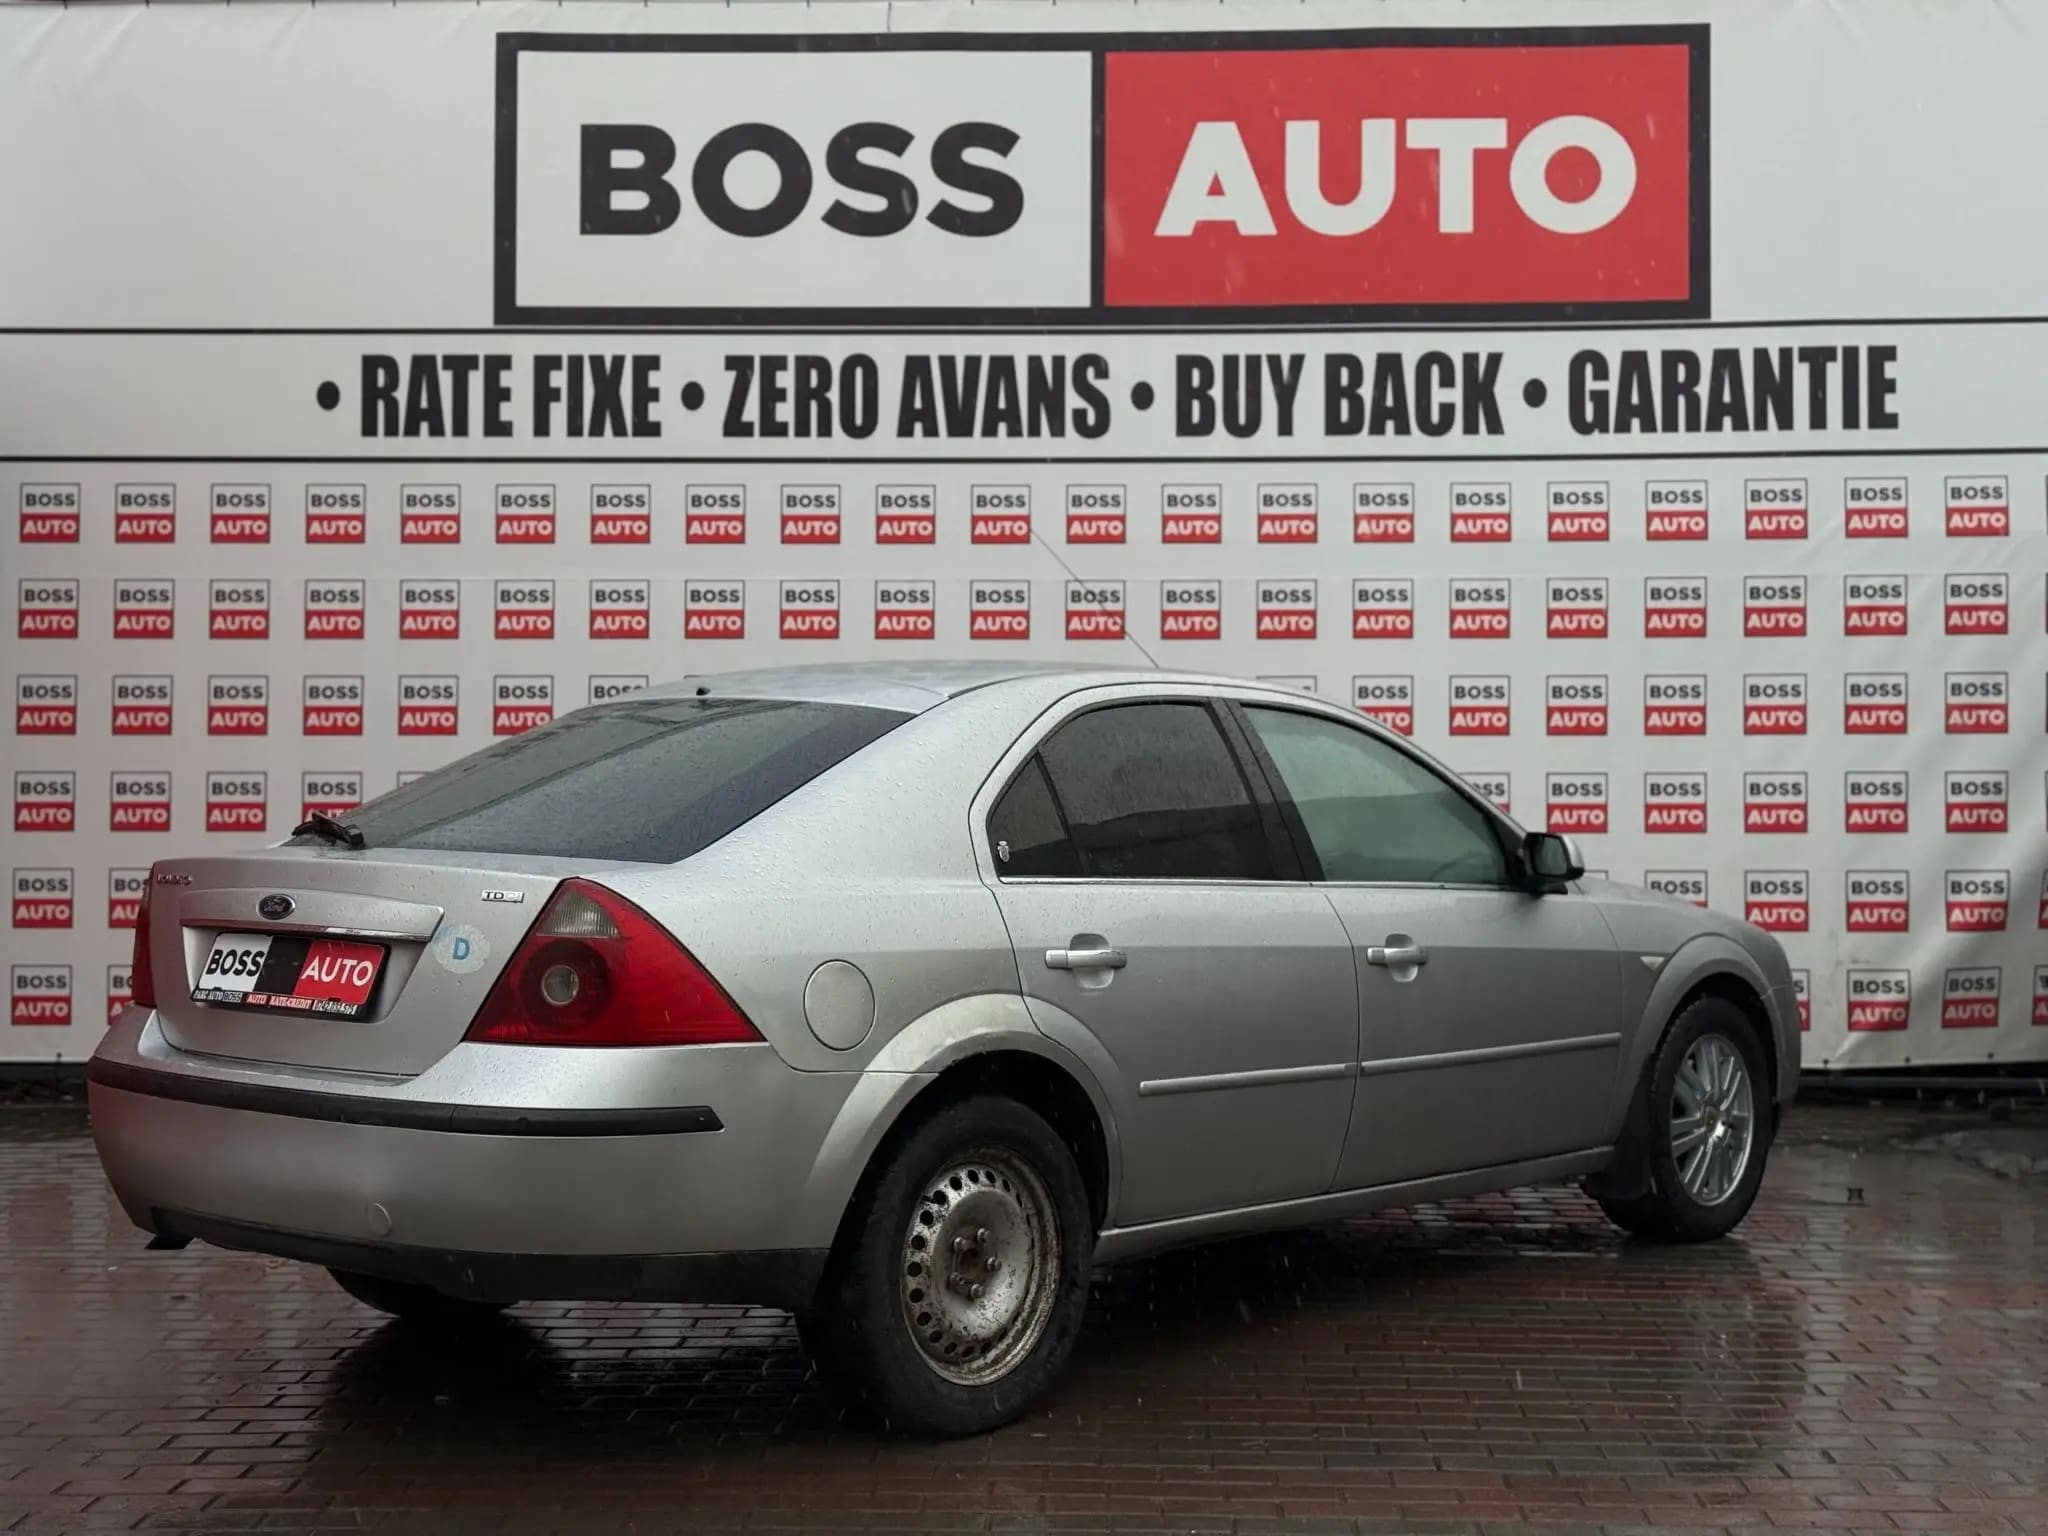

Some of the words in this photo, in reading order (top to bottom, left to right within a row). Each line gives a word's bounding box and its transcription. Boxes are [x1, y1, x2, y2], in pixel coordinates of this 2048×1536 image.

[579, 121, 1024, 238] BOSS
[1154, 115, 1638, 238] AUTO
[361, 354, 514, 438] RATE
[532, 354, 662, 438] FIXE
[722, 353, 879, 439] ZERO
[896, 353, 1111, 440] AVANS
[1175, 353, 1306, 439] BUY
[1324, 350, 1505, 438] BACK
[1568, 345, 1899, 436] GARANTIE
[25, 493, 76, 507] BOSS
[120, 493, 171, 507] BOSS
[215, 493, 266, 508] BOSS
[310, 493, 361, 508] BOSS
[405, 493, 456, 508] BOSS
[1166, 493, 1217, 508] BOSS
[1262, 493, 1313, 508] BOSS
[1358, 492, 1410, 507] BOSS
[1455, 492, 1507, 506] BOSS
[1552, 491, 1605, 505] BOSS
[1651, 489, 1703, 504] BOSS
[1750, 488, 1803, 503] BOSS
[1849, 487, 1903, 502] BOSS
[1950, 485, 2004, 500] BOSS
[500, 494, 551, 508] BOSS
[595, 494, 646, 508] BOSS
[690, 494, 741, 508] BOSS
[785, 494, 836, 509] BOSS
[880, 494, 931, 509] BOSS
[975, 494, 1027, 509] BOSS
[1071, 494, 1121, 508] BOSS
[23, 519, 78, 535] AUTO
[118, 519, 173, 535] AUTO
[213, 519, 268, 535] AUTO
[308, 519, 363, 535] AUTO
[403, 520, 458, 536] AUTO
[498, 520, 553, 536] AUTO
[593, 520, 648, 536] AUTO
[688, 520, 743, 536] AUTO
[783, 520, 838, 536] AUTO
[878, 520, 934, 536] AUTO
[973, 520, 1029, 536] AUTO
[1069, 520, 1124, 536] AUTO
[1164, 519, 1220, 536] AUTO
[1260, 519, 1315, 535] AUTO
[1356, 518, 1412, 535] AUTO
[1453, 518, 1509, 534] AUTO
[1550, 517, 1607, 533] AUTO
[1649, 516, 1706, 532] AUTO
[1748, 514, 1806, 531] AUTO
[1848, 513, 1906, 530] AUTO
[1948, 512, 2007, 529] AUTO
[23, 588, 75, 603] BOSS
[119, 588, 170, 603] BOSS
[214, 589, 265, 603] BOSS
[309, 589, 360, 604] BOSS
[404, 589, 455, 604] BOSS
[499, 589, 550, 604] BOSS
[594, 589, 645, 603] BOSS
[689, 589, 740, 603] BOSS
[785, 589, 835, 604] BOSS
[879, 589, 930, 604] BOSS
[975, 589, 1026, 604] BOSS
[1165, 589, 1217, 604] BOSS
[1261, 589, 1313, 603] BOSS
[1357, 588, 1409, 603] BOSS
[1454, 588, 1506, 603] BOSS
[1551, 587, 1604, 602] BOSS
[1650, 586, 1702, 601] BOSS
[1749, 585, 1802, 601] BOSS
[1849, 584, 1903, 599] BOSS
[1949, 583, 2003, 598] BOSS
[21, 615, 76, 630] AUTO
[116, 615, 172, 631] AUTO
[212, 615, 267, 631] AUTO
[307, 615, 362, 631] AUTO
[402, 615, 457, 631] AUTO
[497, 615, 552, 631] AUTO
[592, 615, 647, 631] AUTO
[687, 615, 742, 631] AUTO
[782, 615, 837, 631] AUTO
[878, 615, 933, 631] AUTO
[972, 615, 1028, 631] AUTO
[1163, 615, 1219, 632] AUTO
[1259, 615, 1315, 631] AUTO
[1355, 614, 1411, 631] AUTO
[1452, 614, 1508, 631] AUTO
[1549, 614, 1606, 630] AUTO
[1647, 613, 1705, 629] AUTO
[1747, 612, 1804, 629] AUTO
[1847, 611, 1904, 628] AUTO
[1948, 610, 2005, 627] AUTO
[21, 685, 73, 699] BOSS
[117, 685, 169, 700] BOSS
[213, 685, 264, 700] BOSS
[308, 685, 359, 700] BOSS
[403, 685, 454, 700] BOSS
[498, 685, 549, 700] BOSS
[1357, 685, 1409, 700] BOSS
[1454, 685, 1506, 700] BOSS
[1551, 685, 1603, 700] BOSS
[1649, 684, 1702, 699] BOSS
[1748, 684, 1802, 699] BOSS
[1849, 683, 1903, 698] BOSS
[1951, 682, 2003, 697] BOSS
[19, 711, 74, 727] AUTO
[114, 711, 170, 727] AUTO
[210, 711, 266, 727] AUTO
[306, 711, 361, 727] AUTO
[401, 711, 456, 727] AUTO
[1451, 711, 1508, 728] AUTO
[1549, 711, 1605, 727] AUTO
[1647, 711, 1704, 727] AUTO
[1746, 710, 1805, 727] AUTO
[1847, 709, 1904, 726] AUTO
[1949, 709, 2006, 725] AUTO
[19, 781, 71, 796] BOSS
[115, 781, 167, 796] BOSS
[211, 781, 262, 796] BOSS
[1551, 782, 1603, 797] BOSS
[1649, 782, 1702, 797] BOSS
[1749, 782, 1803, 797] BOSS
[1850, 781, 1904, 797] BOSS
[1950, 781, 2004, 797] BOSS
[17, 807, 72, 823] AUTO
[113, 808, 169, 823] AUTO
[209, 808, 264, 824] AUTO
[1549, 809, 1606, 825] AUTO
[1647, 809, 1704, 825] AUTO
[1747, 808, 1805, 825] AUTO
[1848, 809, 1905, 825] AUTO
[1948, 808, 2006, 825] AUTO
[18, 877, 69, 892] BOSS
[1749, 880, 1804, 895] BOSS
[1851, 880, 1904, 895] BOSS
[1950, 880, 2003, 896] BOSS
[16, 904, 71, 920] AUTO
[1849, 907, 1905, 924] AUTO
[1948, 907, 2004, 924] AUTO
[452, 936, 471, 961] D
[205, 949, 265, 976] BOSS
[301, 955, 373, 988] AUTO
[17, 975, 67, 990] BOSS
[16, 1001, 68, 1017] AUTO
